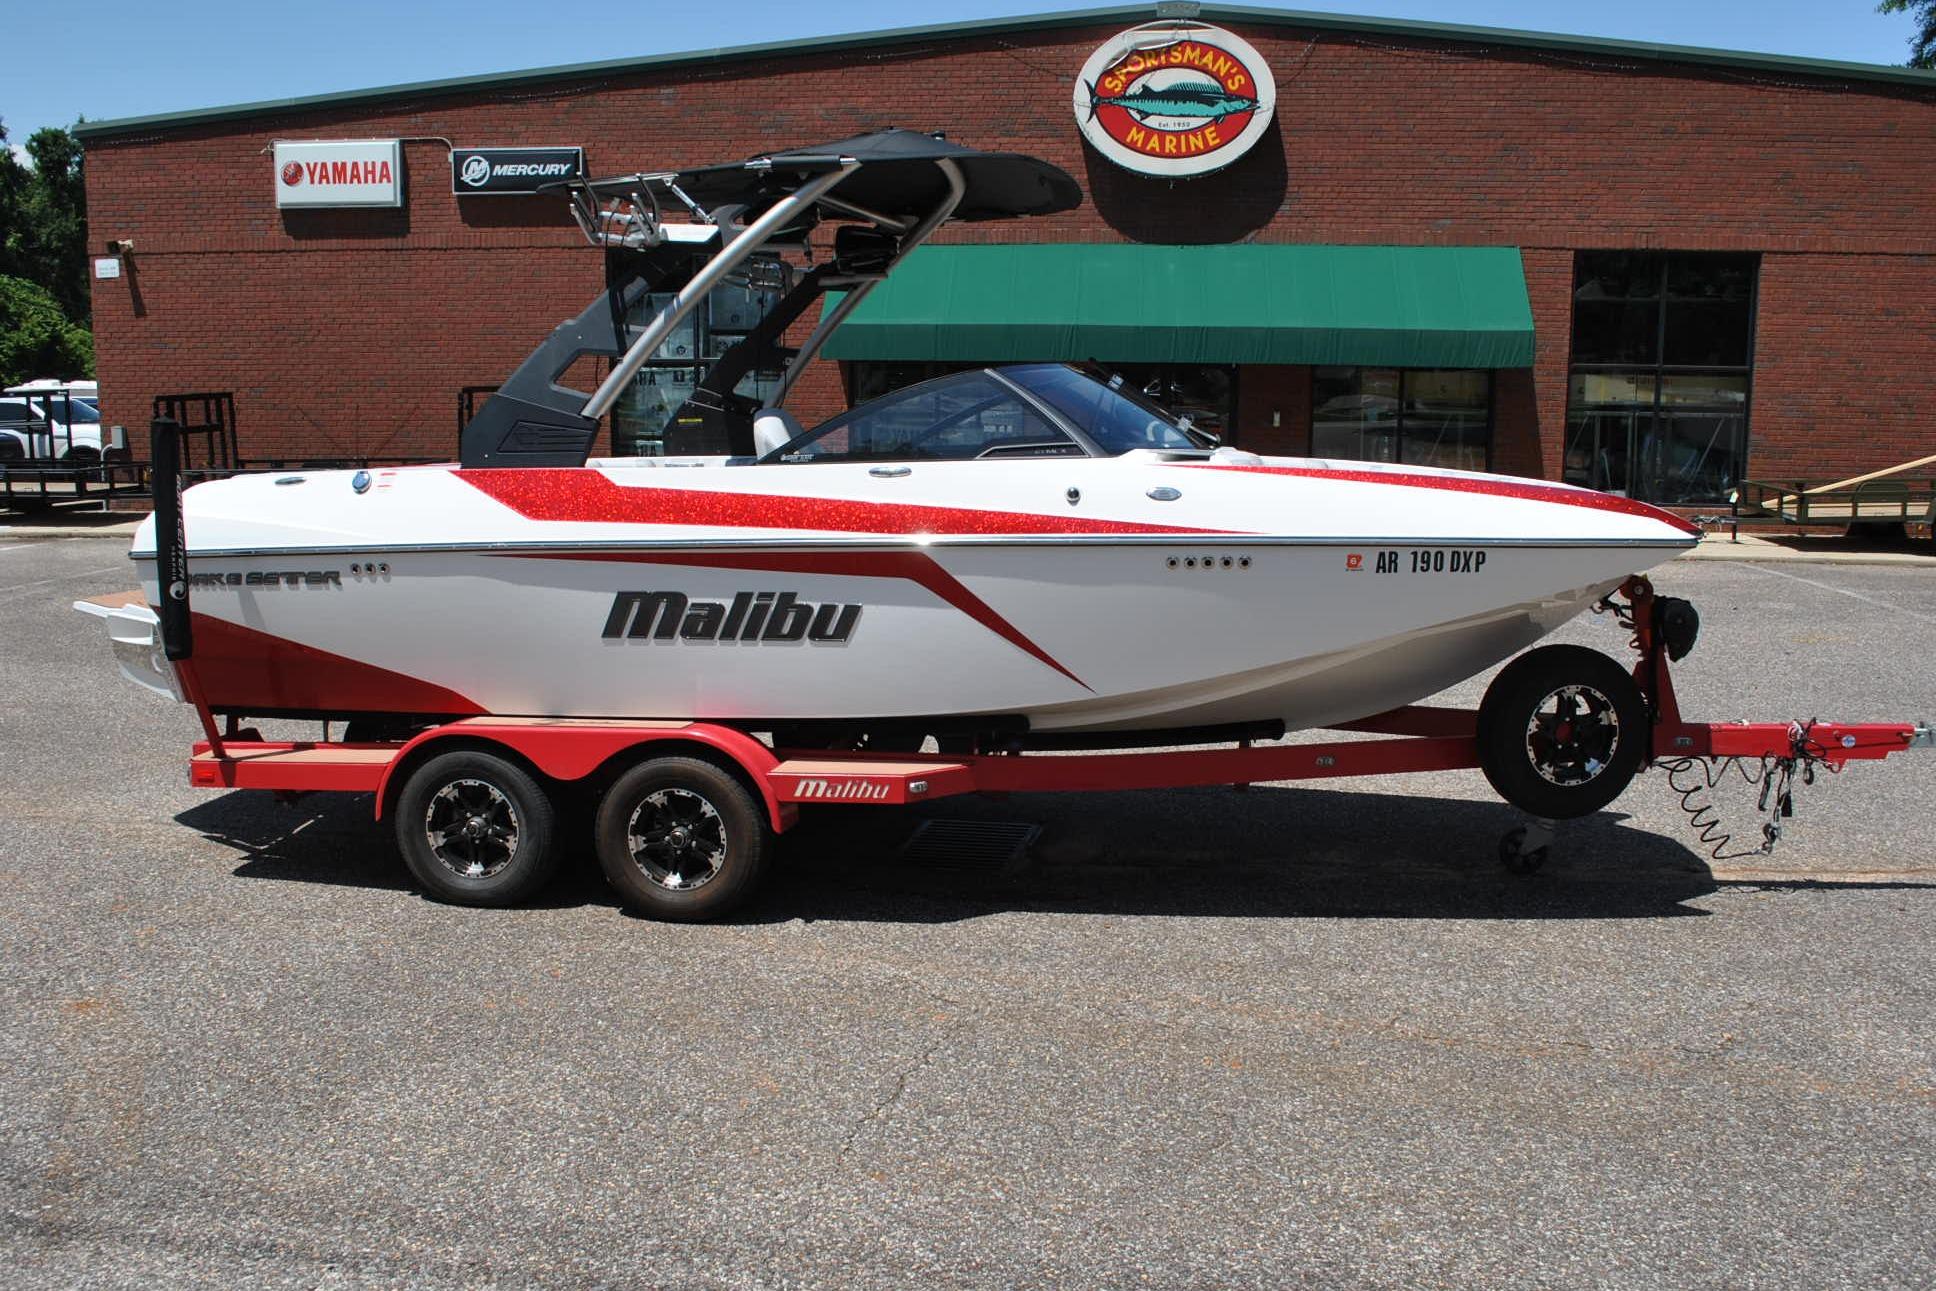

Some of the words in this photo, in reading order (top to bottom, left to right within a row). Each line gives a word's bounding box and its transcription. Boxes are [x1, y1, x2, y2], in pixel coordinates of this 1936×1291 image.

[1126, 126, 1220, 154] MARINE
[305, 160, 392, 185] YAMAHA
[492, 163, 572, 177] MERCURY
[1375, 550, 1399, 574] AR
[1410, 550, 1445, 573] 190
[1449, 550, 1487, 573] DXP
[246, 570, 343, 587] SETTER
[600, 590, 864, 643] Malibu
[793, 779, 891, 799] Malibu
